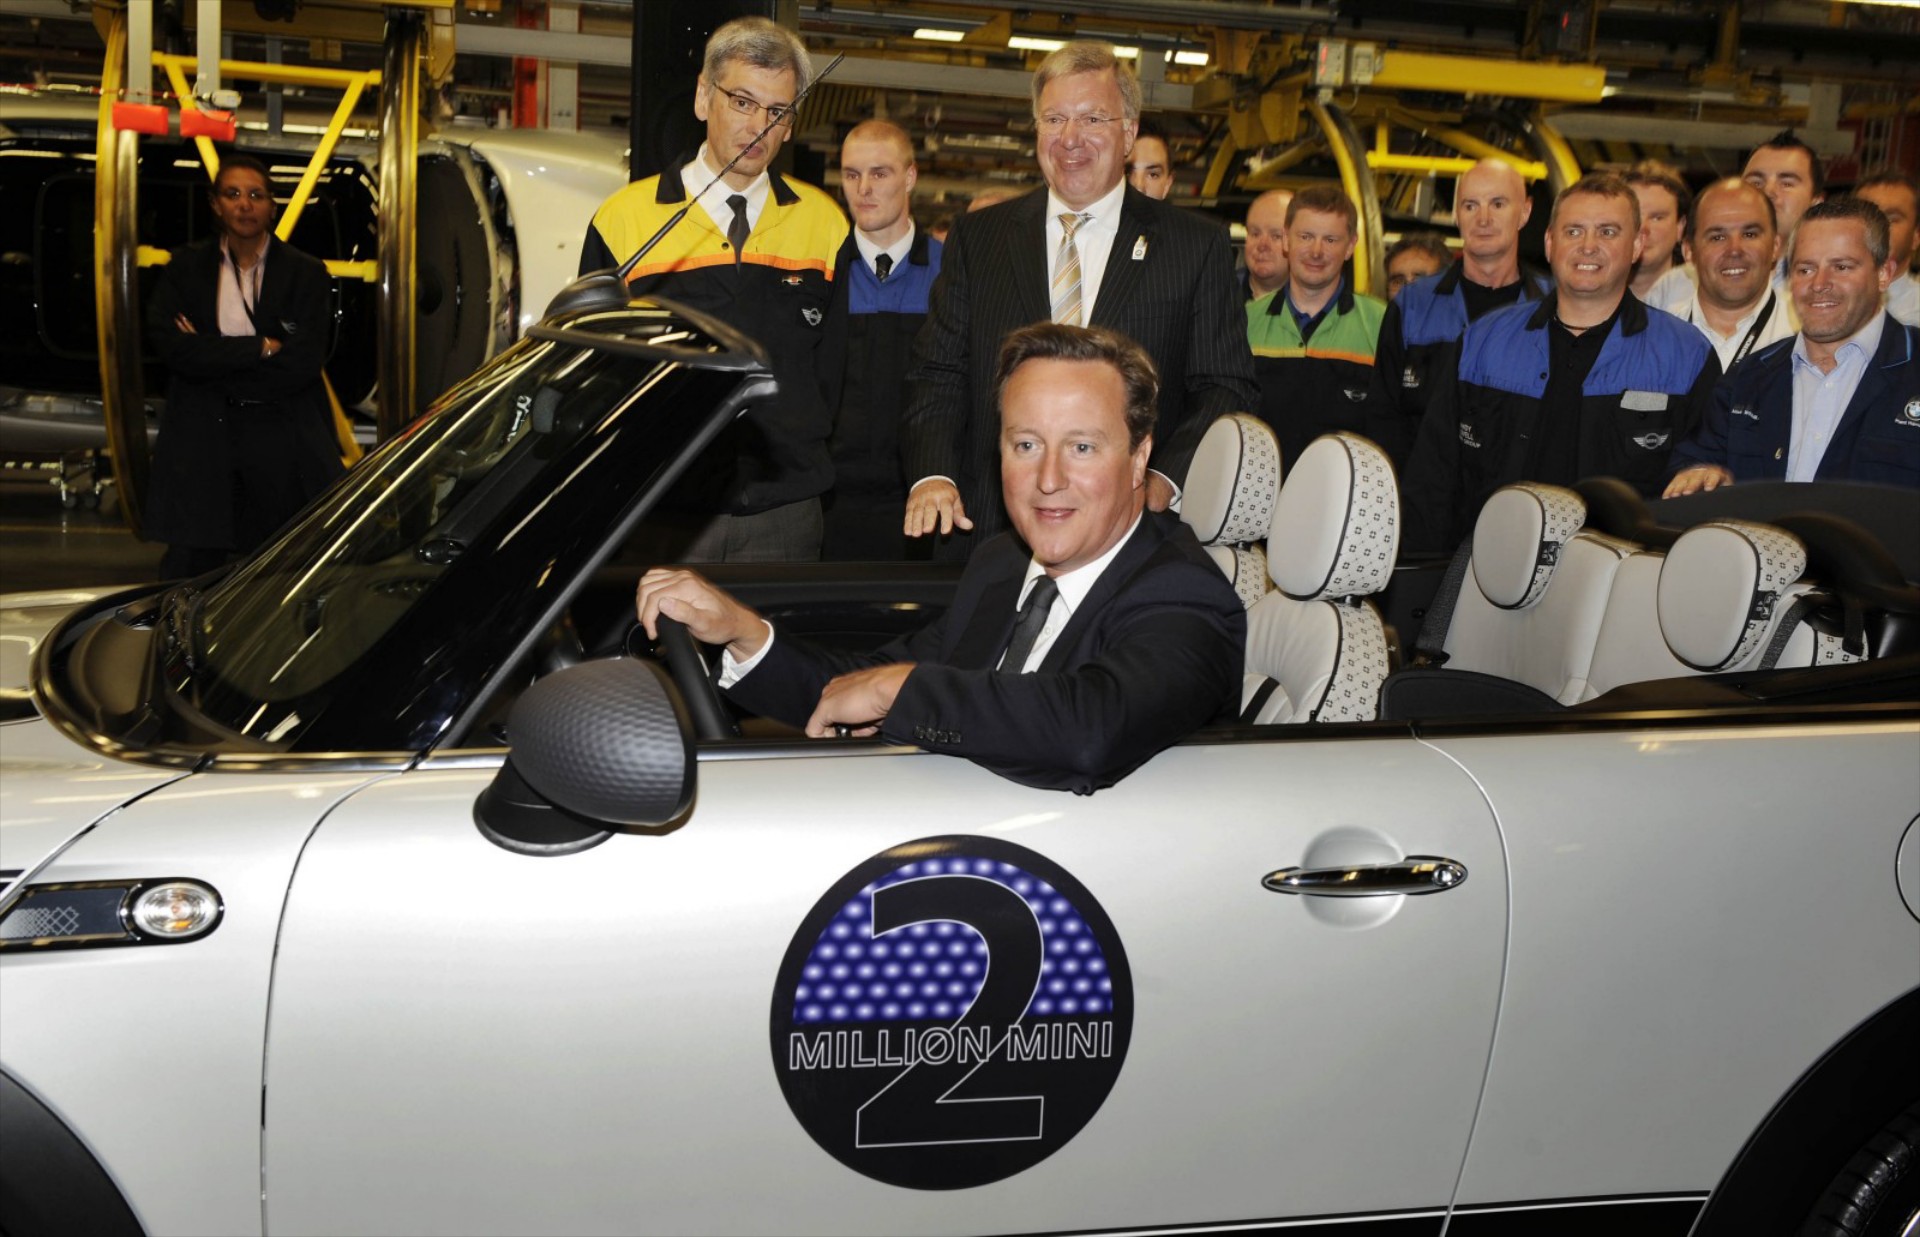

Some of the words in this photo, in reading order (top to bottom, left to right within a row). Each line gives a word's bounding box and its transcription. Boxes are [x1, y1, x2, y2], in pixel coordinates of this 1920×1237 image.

[789, 1025, 991, 1071] MILLION
[1007, 1020, 1113, 1062] MINI
[856, 873, 1044, 1149] 2
